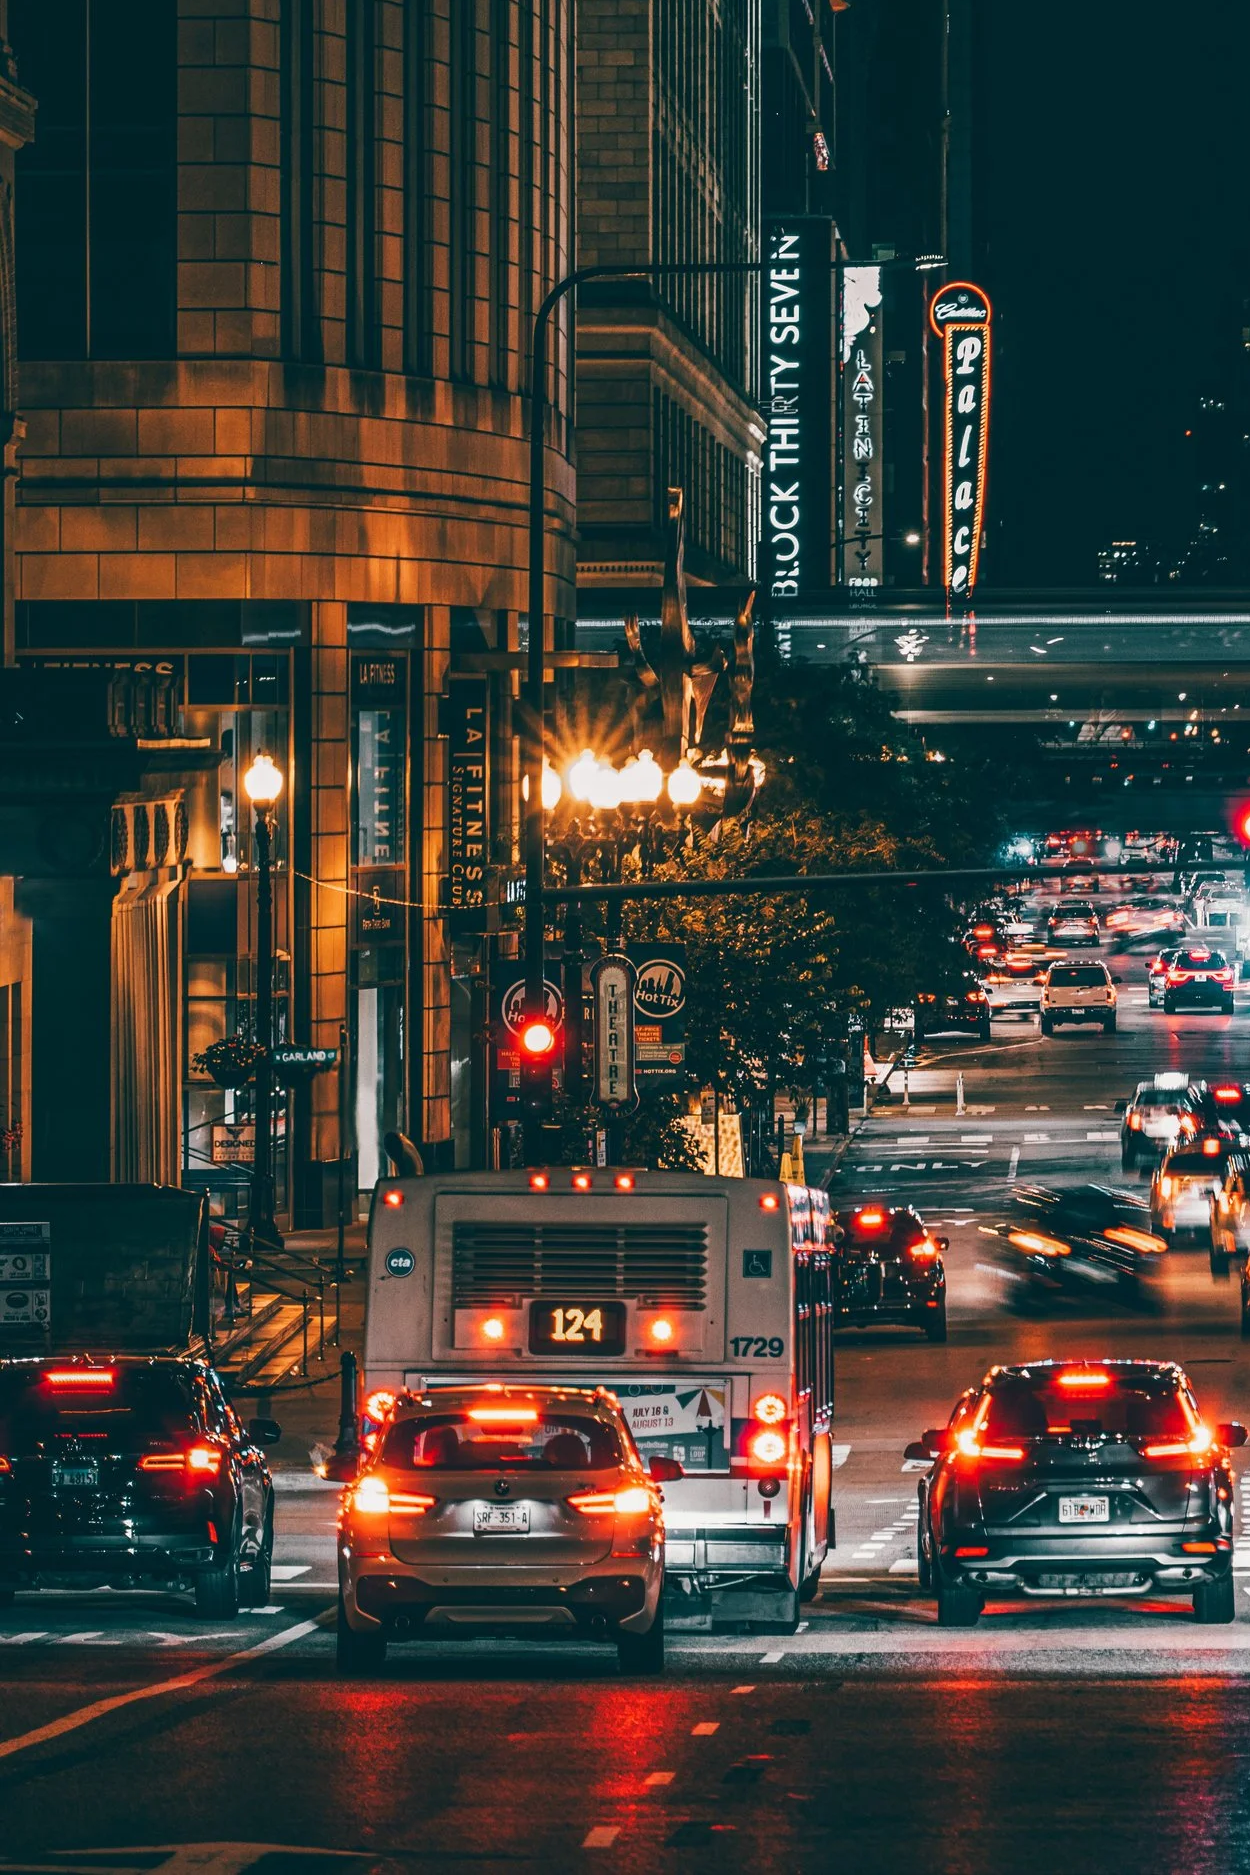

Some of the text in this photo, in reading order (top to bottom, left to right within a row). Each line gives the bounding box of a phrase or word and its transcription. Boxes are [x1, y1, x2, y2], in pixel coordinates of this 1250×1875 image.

[770, 228, 800, 598] BLOCK THIRTY SEVEN
[852, 349, 874, 572] LATINICITY
[951, 336, 983, 595] Palace
[849, 578, 878, 587] FOOD
[850, 589, 877, 597] HALL
[360, 663, 395, 684] LA FITNESS
[466, 707, 483, 904] LA FITNESS
[452, 766, 464, 906] SIGNATURE CLUB
[608, 984, 618, 1095] THEATRE
[282, 1051, 326, 1062] GARLAND
[854, 1160, 989, 1173] ONLY
[391, 1257, 412, 1269] cta
[551, 1308, 602, 1342] 124
[730, 1336, 785, 1359] 1729
[631, 1417, 674, 1429] AUGUST 13
[632, 1408, 650, 1418] JULY
[652, 1407, 661, 1417] 16
[476, 1511, 528, 1524] SRF-351-A
